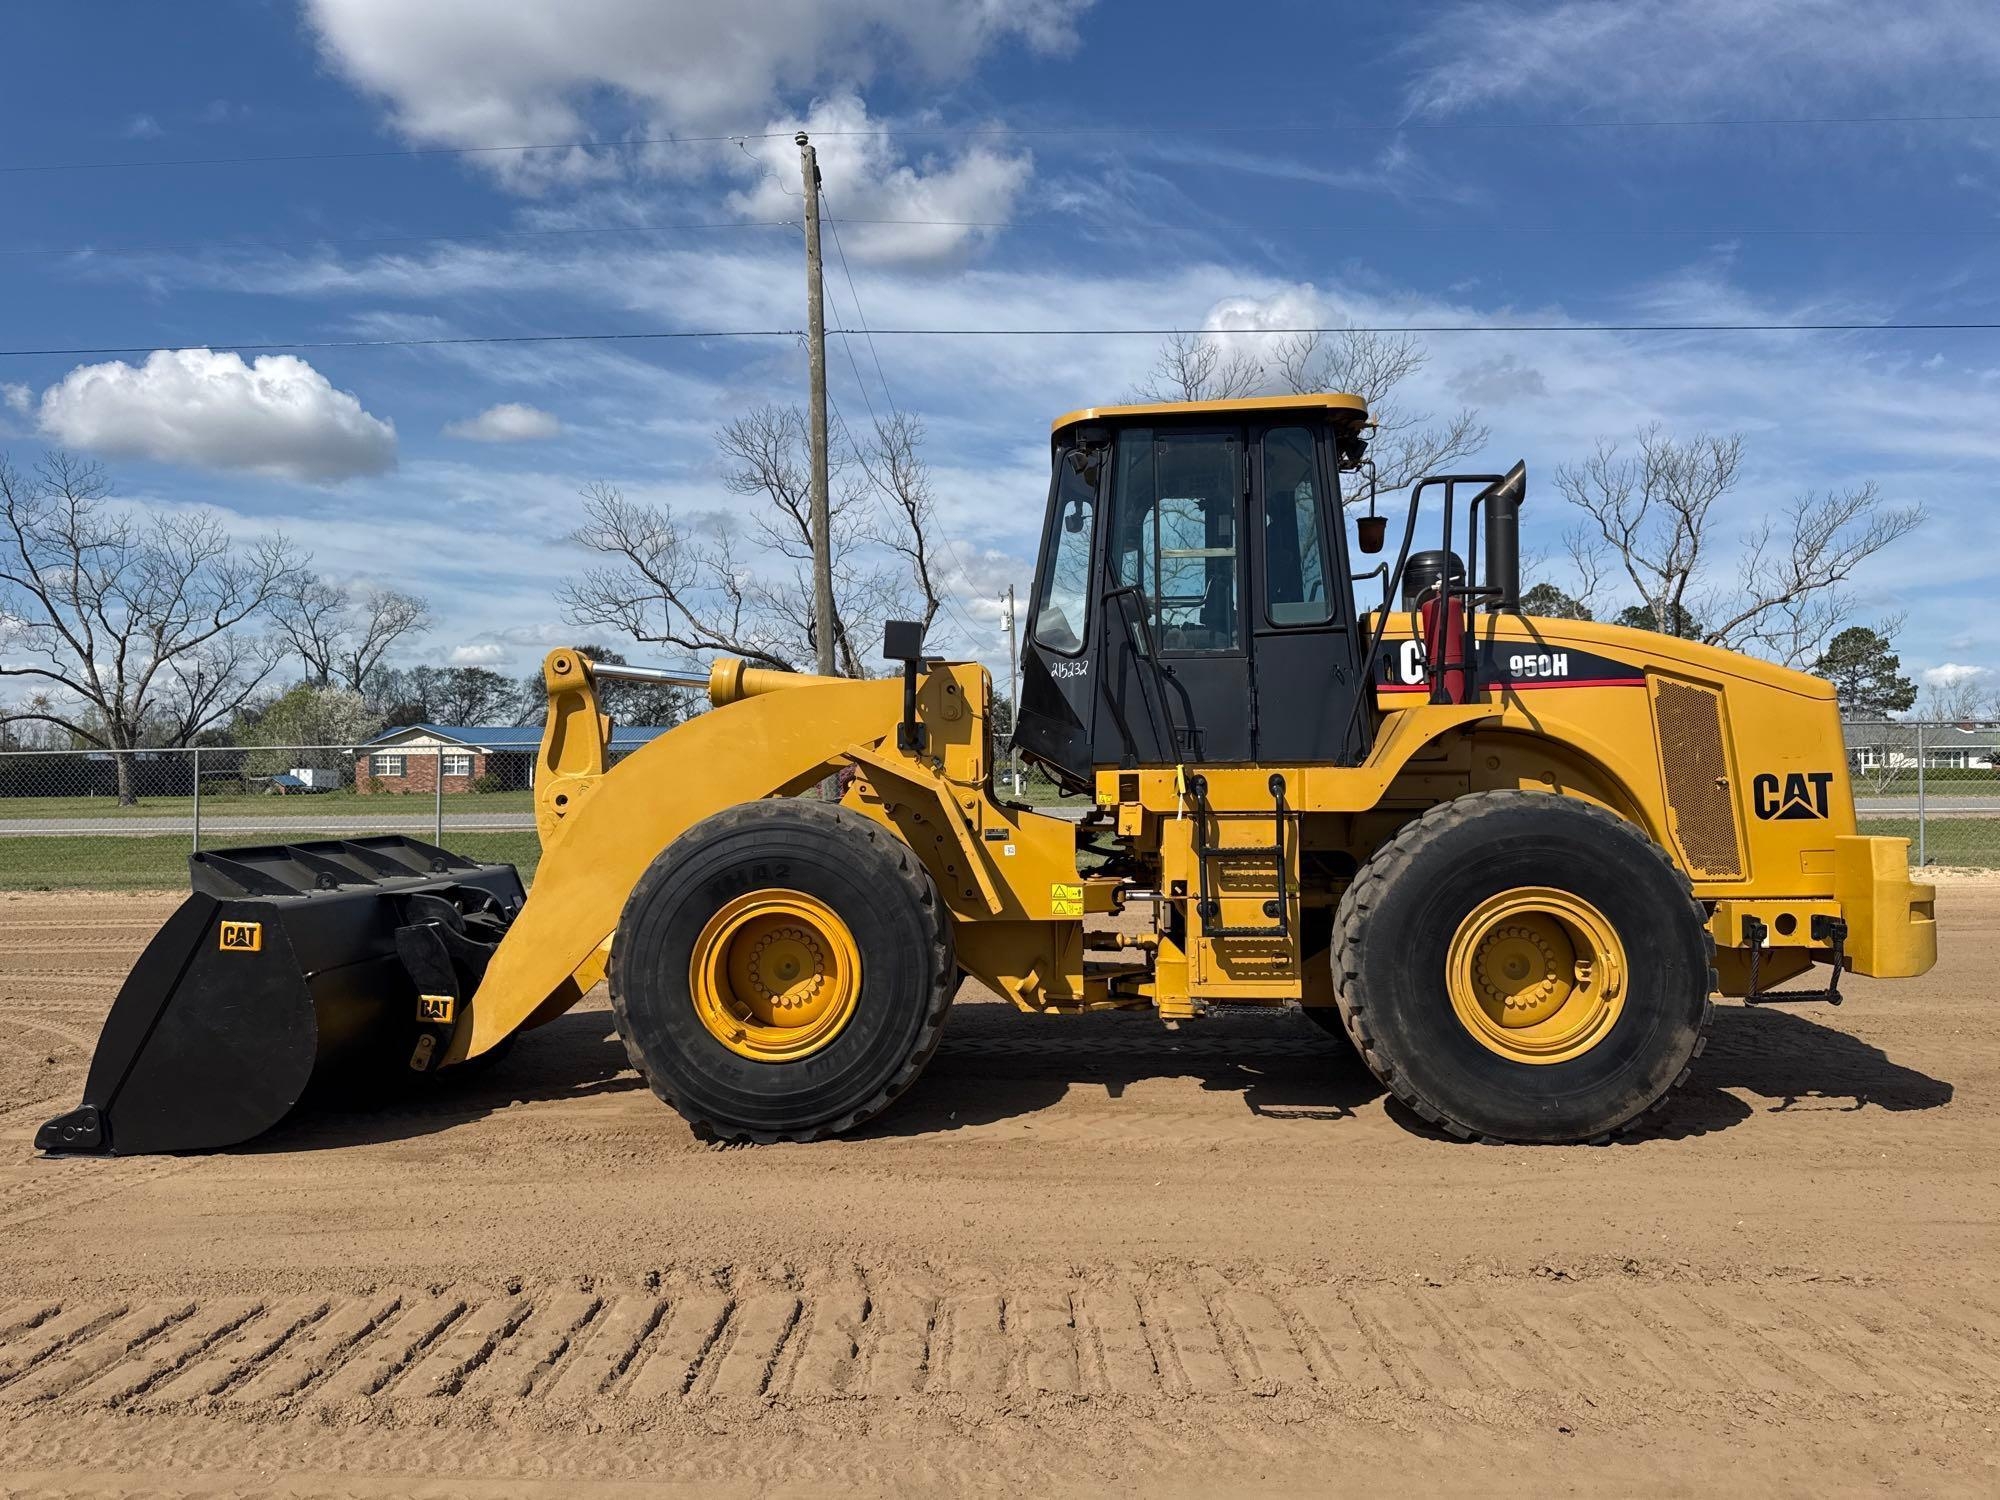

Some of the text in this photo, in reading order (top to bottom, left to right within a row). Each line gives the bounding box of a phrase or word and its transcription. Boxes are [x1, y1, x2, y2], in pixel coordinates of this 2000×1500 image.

[1051, 660, 1089, 678] 215232
[1510, 653, 1568, 677] 950H
[1753, 772, 1833, 820] CAT
[223, 926, 257, 947] CAT
[420, 1000, 450, 1018] CAT
